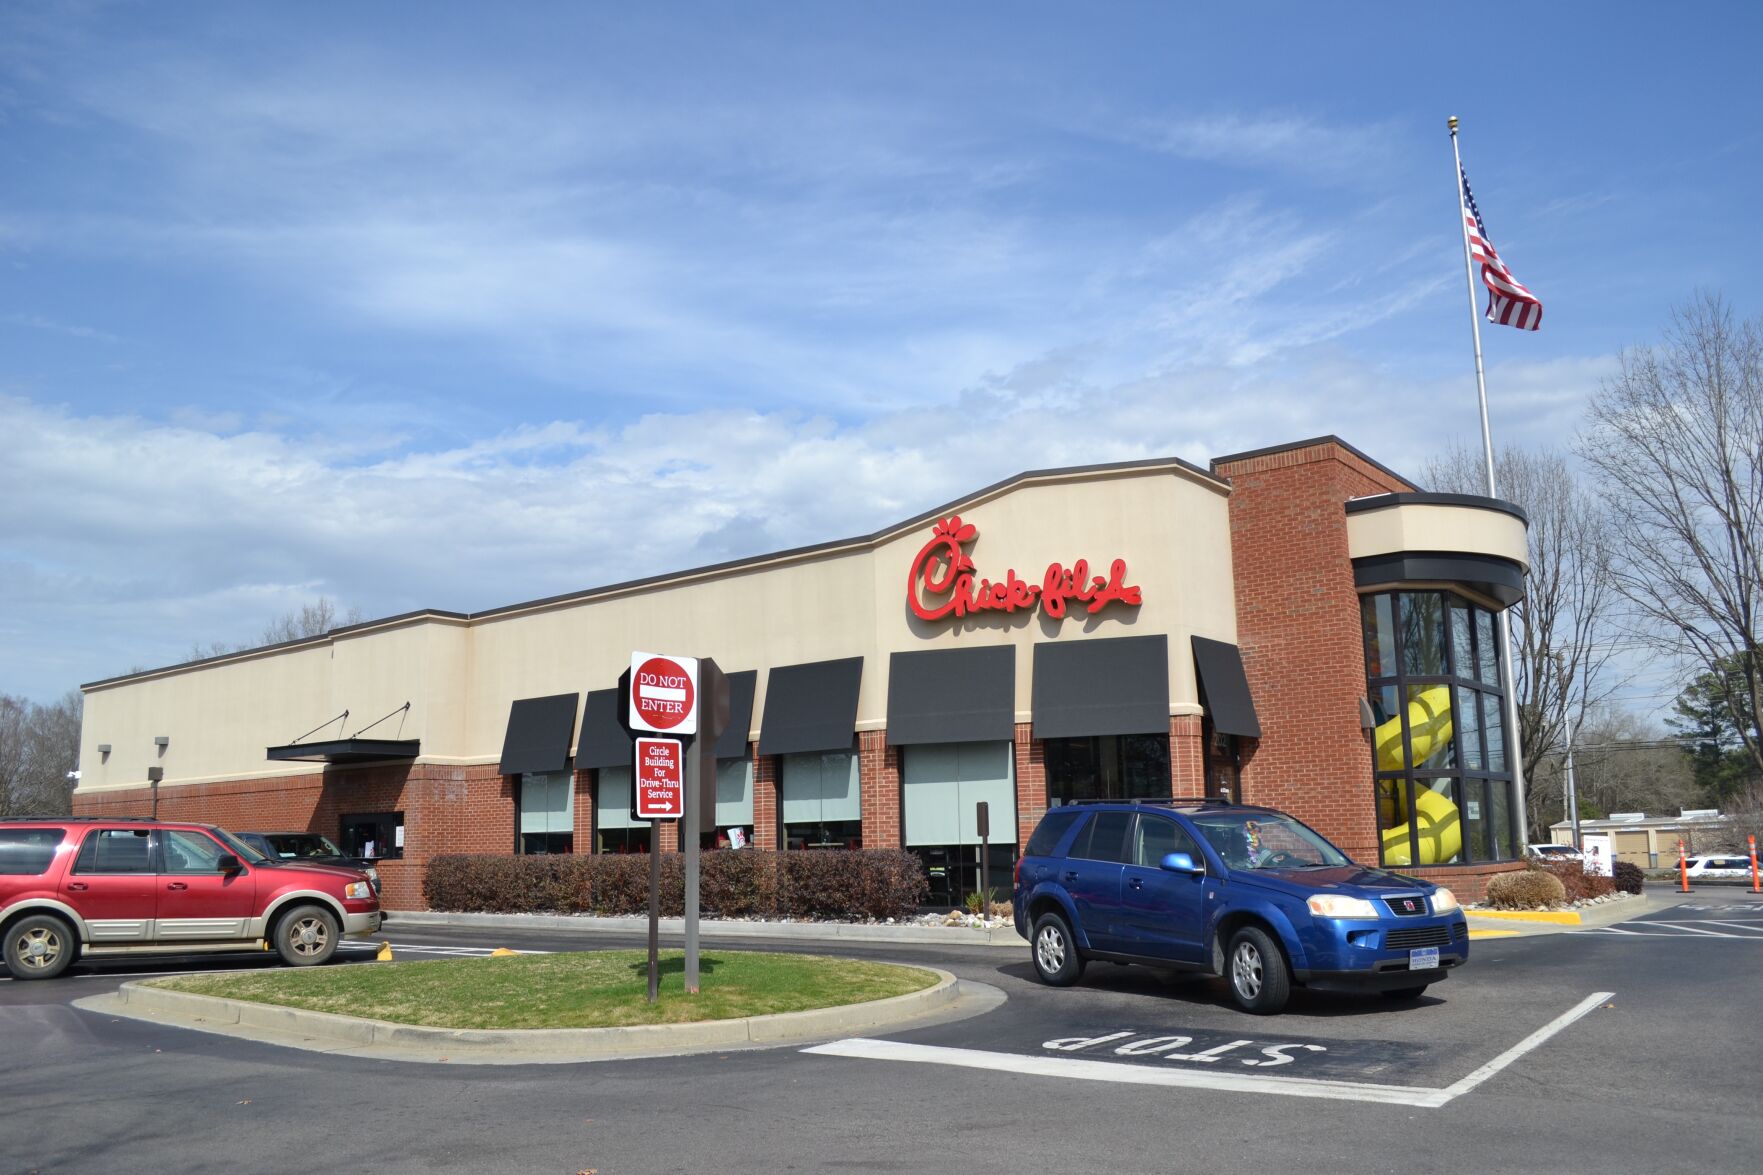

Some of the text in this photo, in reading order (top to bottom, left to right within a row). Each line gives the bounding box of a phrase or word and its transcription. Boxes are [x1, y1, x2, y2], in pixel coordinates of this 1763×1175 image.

[640, 672, 687, 688] DO NOT
[641, 698, 683, 713] ENTER
[649, 746, 670, 757] Circle
[644, 757, 675, 769] Building
[654, 768, 666, 778] For
[640, 778, 680, 788] Drive-Thru
[647, 789, 673, 799] Service
[1042, 1031, 1327, 1066] STOP
